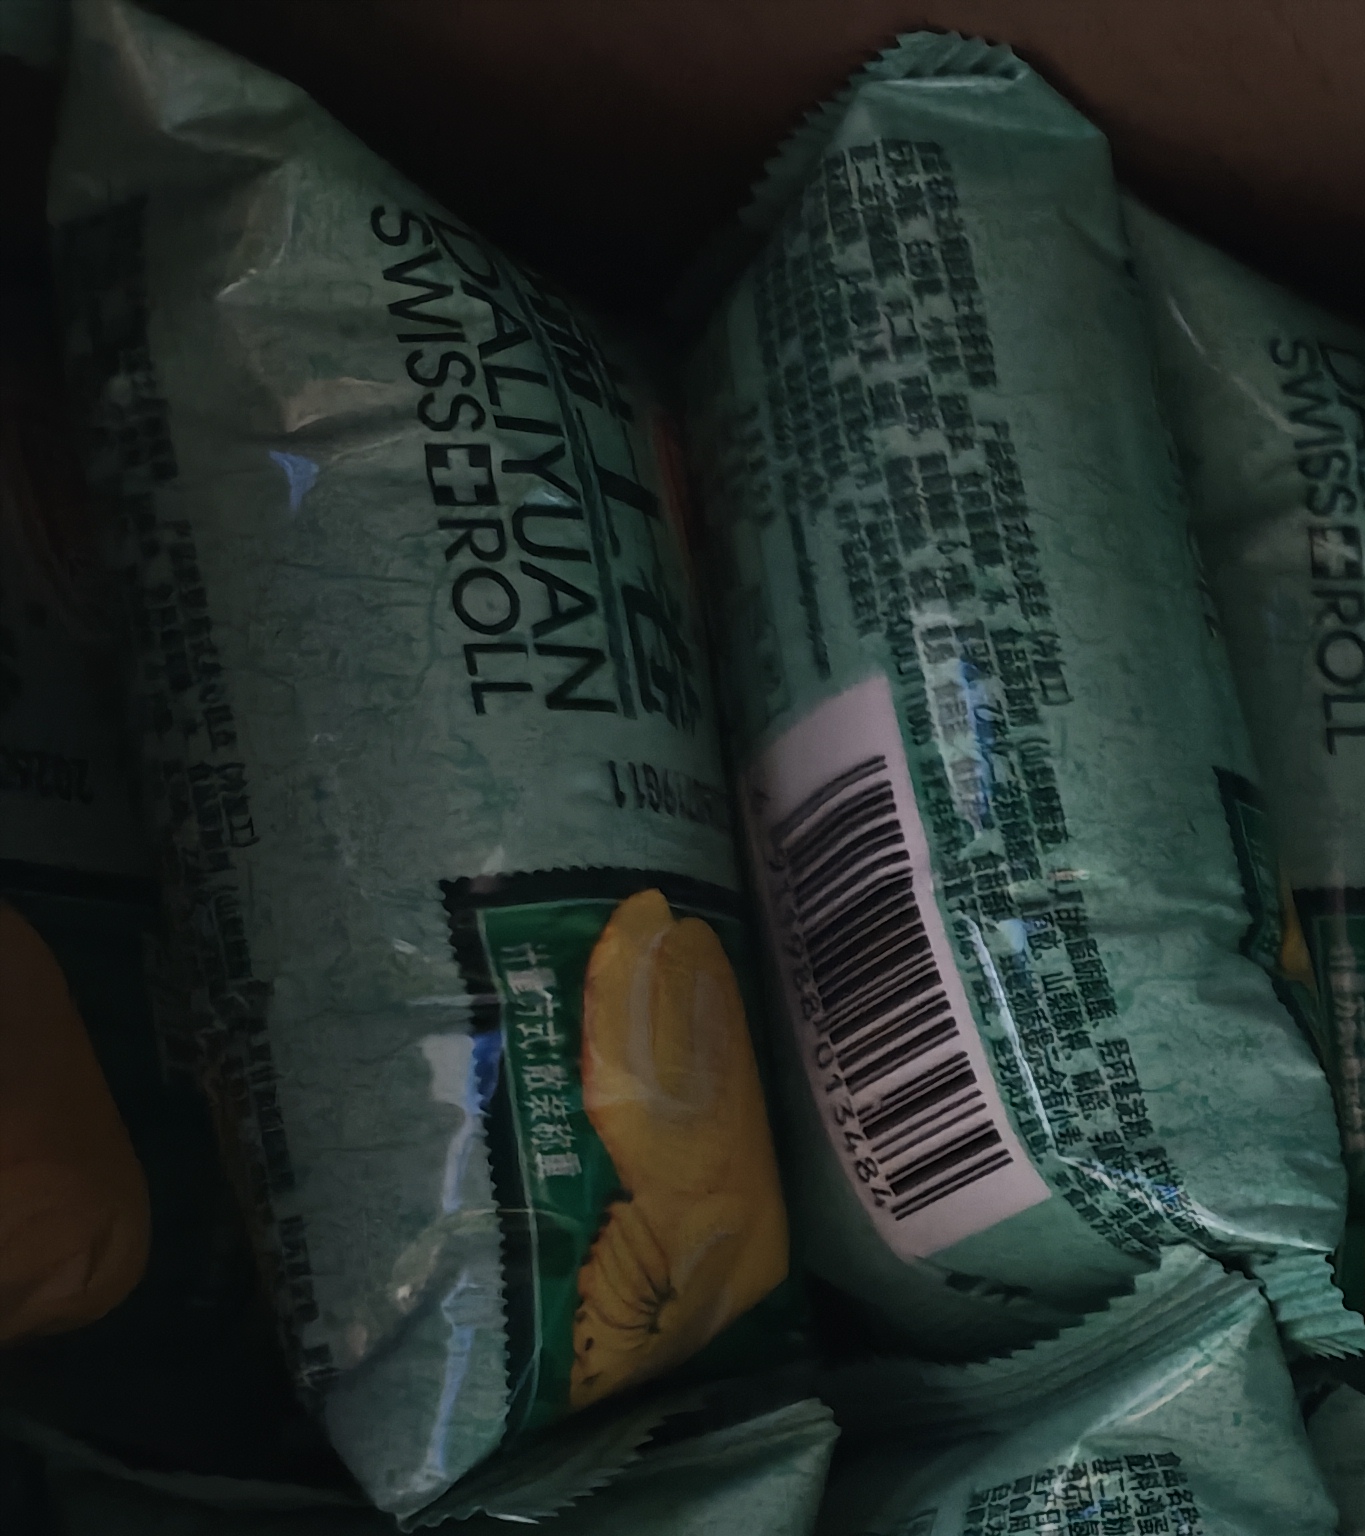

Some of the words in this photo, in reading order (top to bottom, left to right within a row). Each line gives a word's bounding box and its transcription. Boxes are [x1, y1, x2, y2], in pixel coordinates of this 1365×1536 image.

[371, 207, 485, 432] SWISS
[438, 519, 532, 715] ROLL
[430, 217, 616, 712] DALIYUAN
[1271, 338, 1355, 516] SWISS
